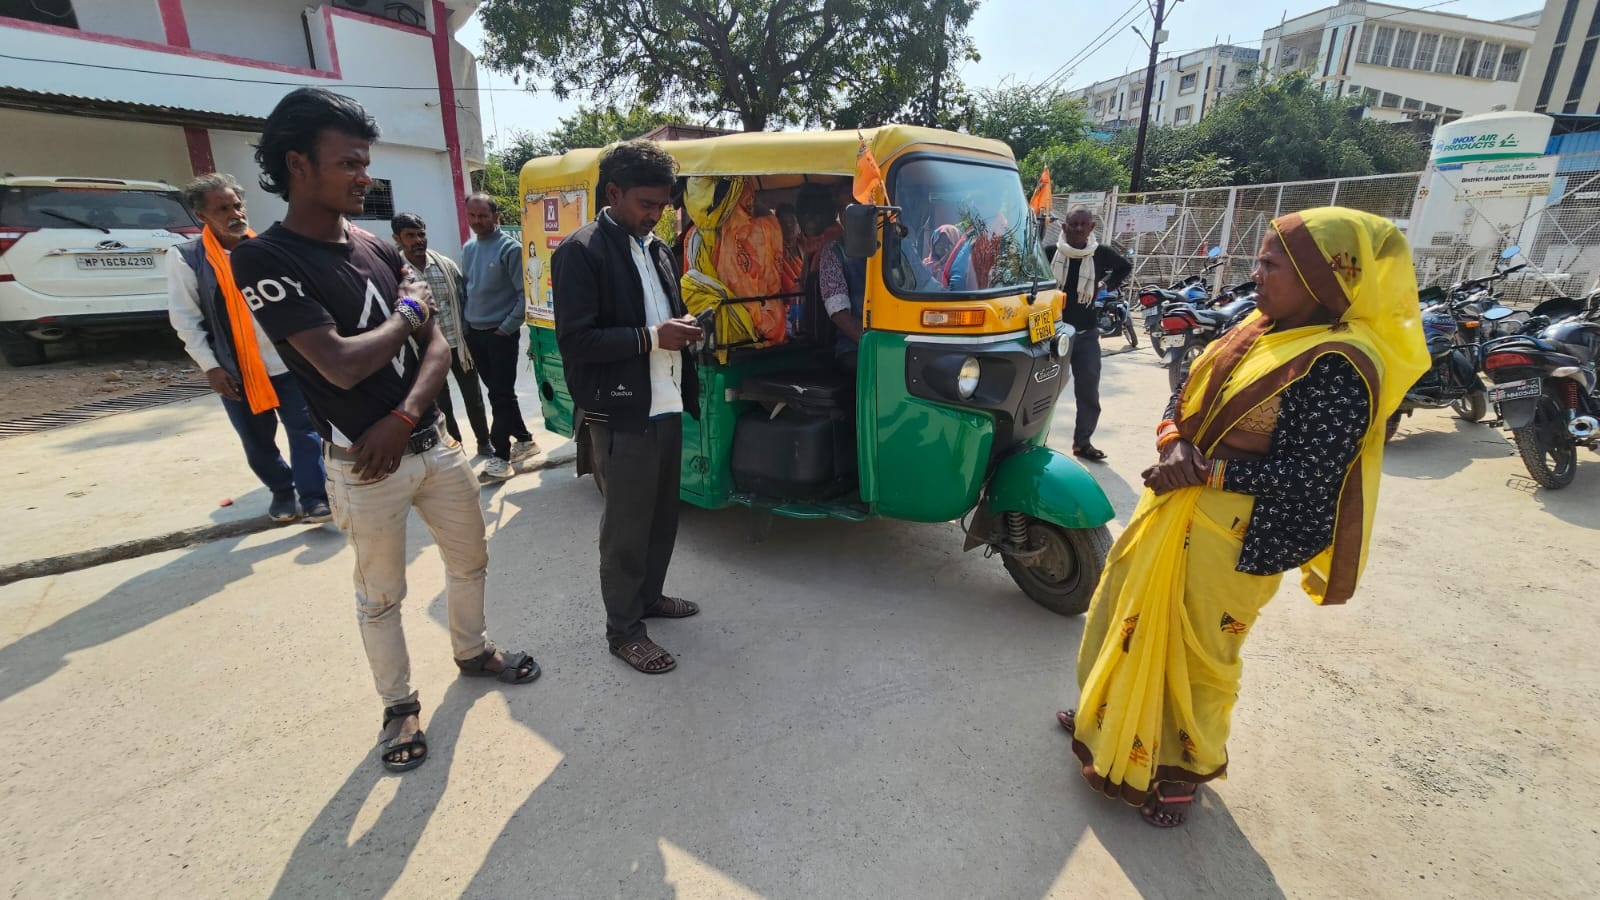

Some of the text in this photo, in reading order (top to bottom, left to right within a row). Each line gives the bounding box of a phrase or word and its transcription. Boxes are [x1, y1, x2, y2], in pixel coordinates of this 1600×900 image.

[1452, 133, 1498, 144] INOX AIR
[1443, 141, 1497, 152] PRODUCTS
[241, 276, 305, 312] BOY
